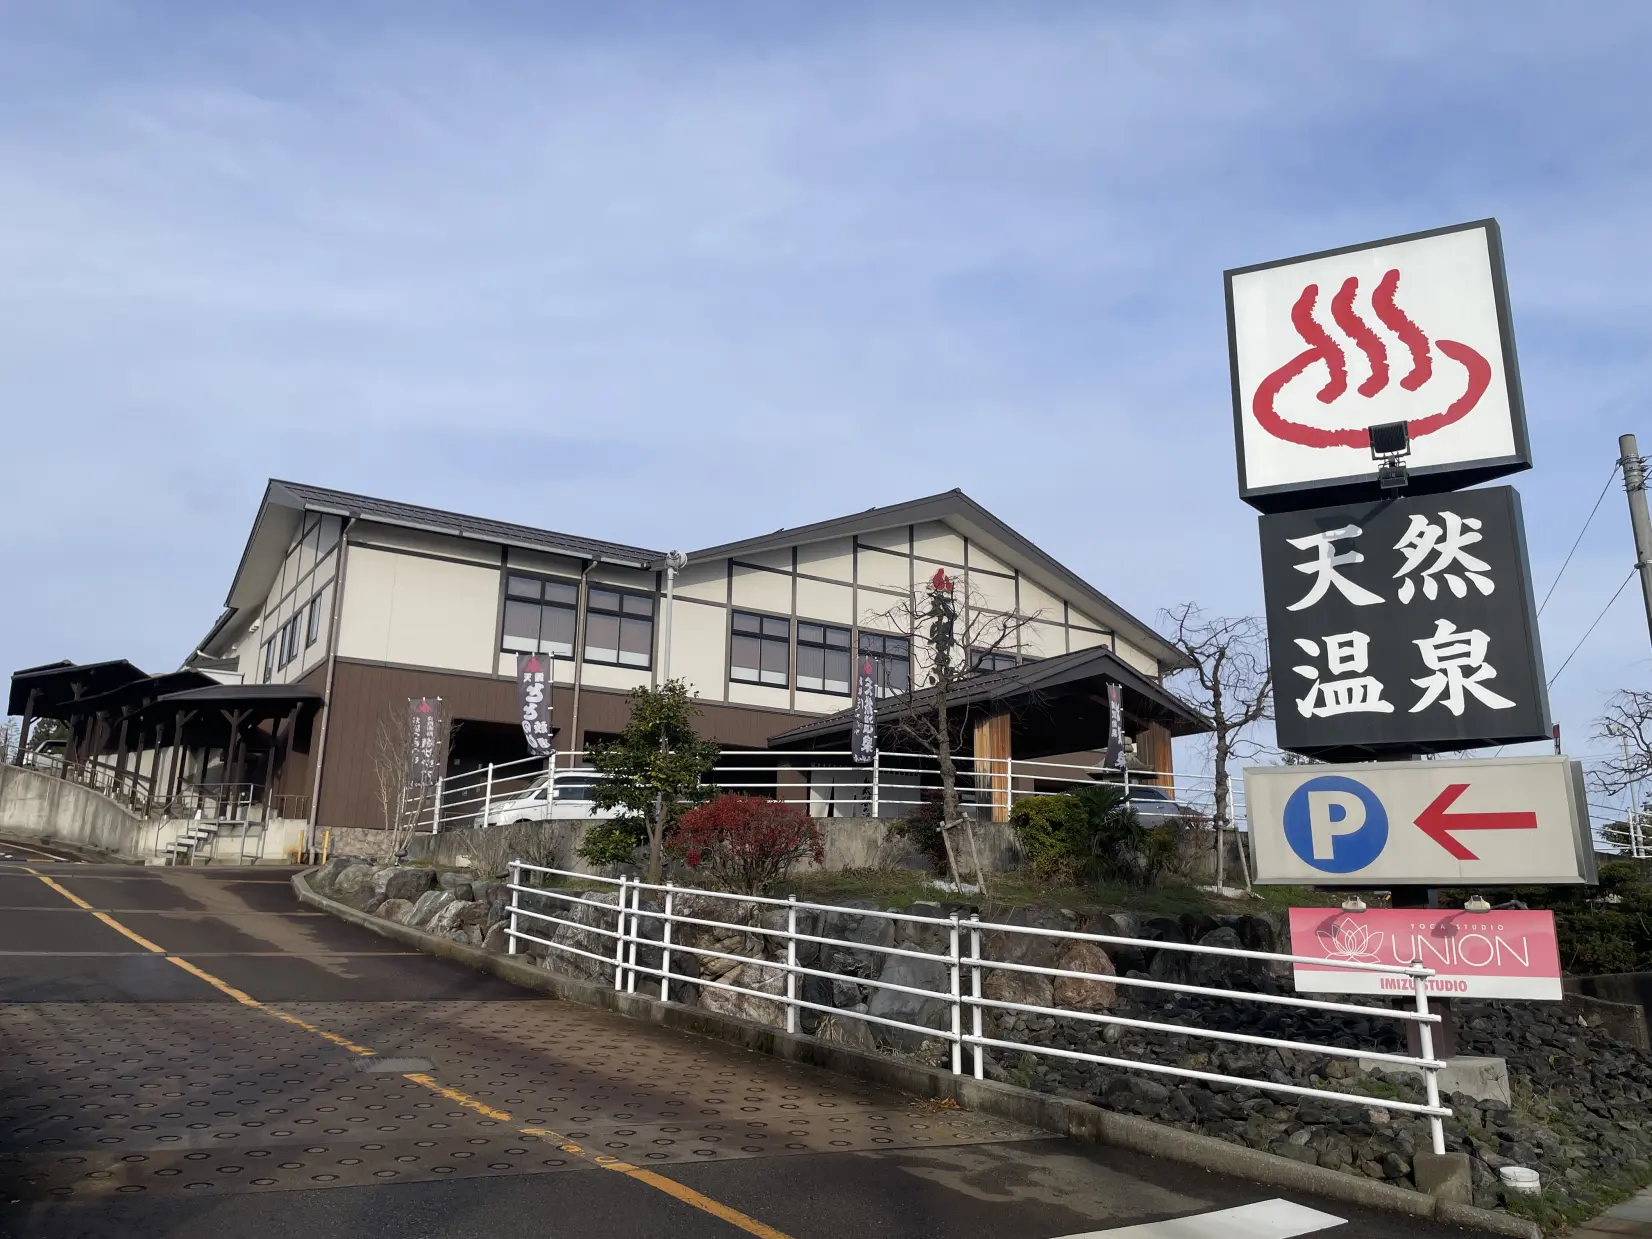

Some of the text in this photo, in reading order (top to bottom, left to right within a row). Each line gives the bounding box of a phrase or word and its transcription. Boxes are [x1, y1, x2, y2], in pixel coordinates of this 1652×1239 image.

[1286, 511, 1496, 612] 天然
[1292, 618, 1517, 718] 温泉
[1307, 789, 1367, 860] P
[1391, 933, 1529, 967] UNION
[1455, 923, 1504, 931] STUDIO
